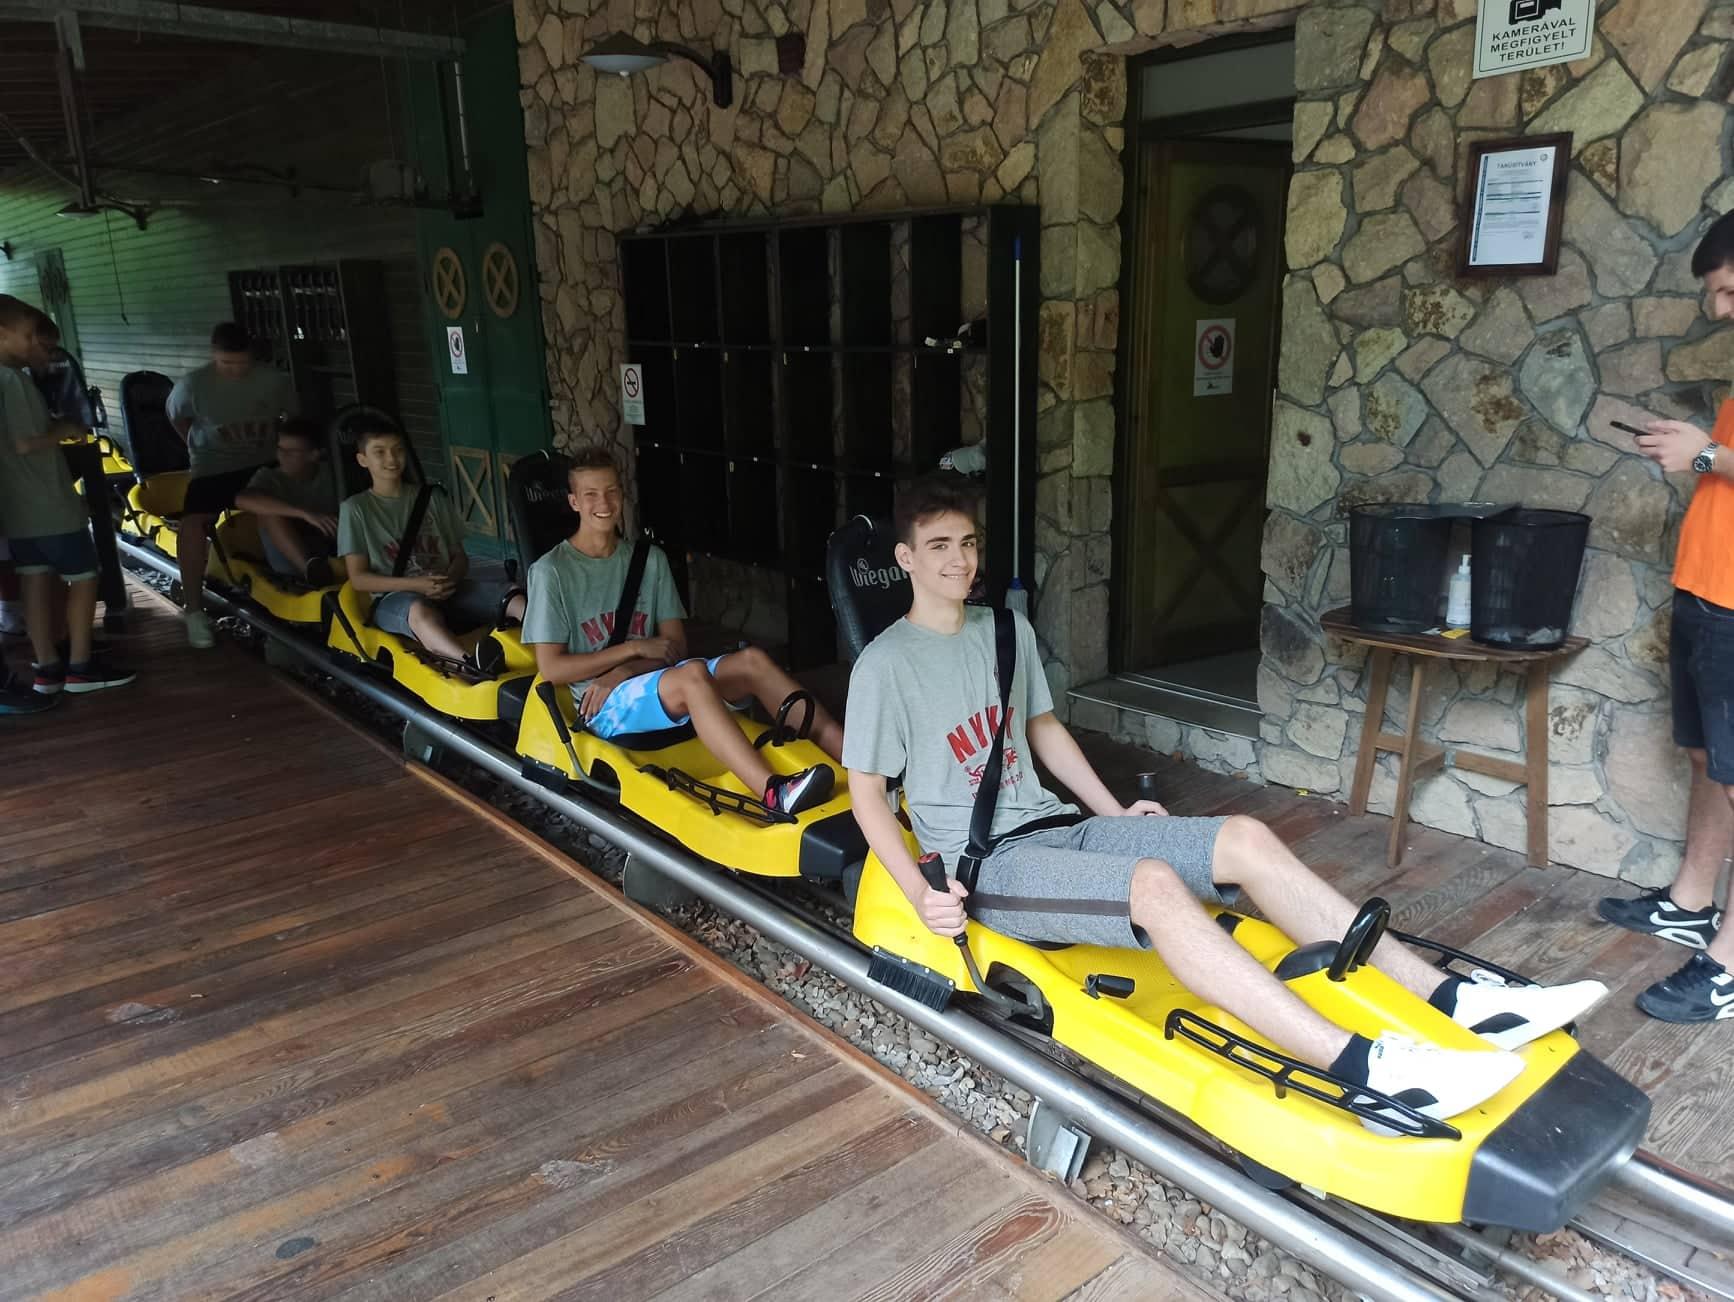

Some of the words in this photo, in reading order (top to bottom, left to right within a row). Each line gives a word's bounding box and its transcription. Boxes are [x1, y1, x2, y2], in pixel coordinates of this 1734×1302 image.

[1490, 28, 1577, 54] MEGFIGYELT
[1492, 16, 1577, 42] KAMERÁVAL
[1499, 41, 1566, 62] TERÜLET!
[580, 611, 649, 646] NYK
